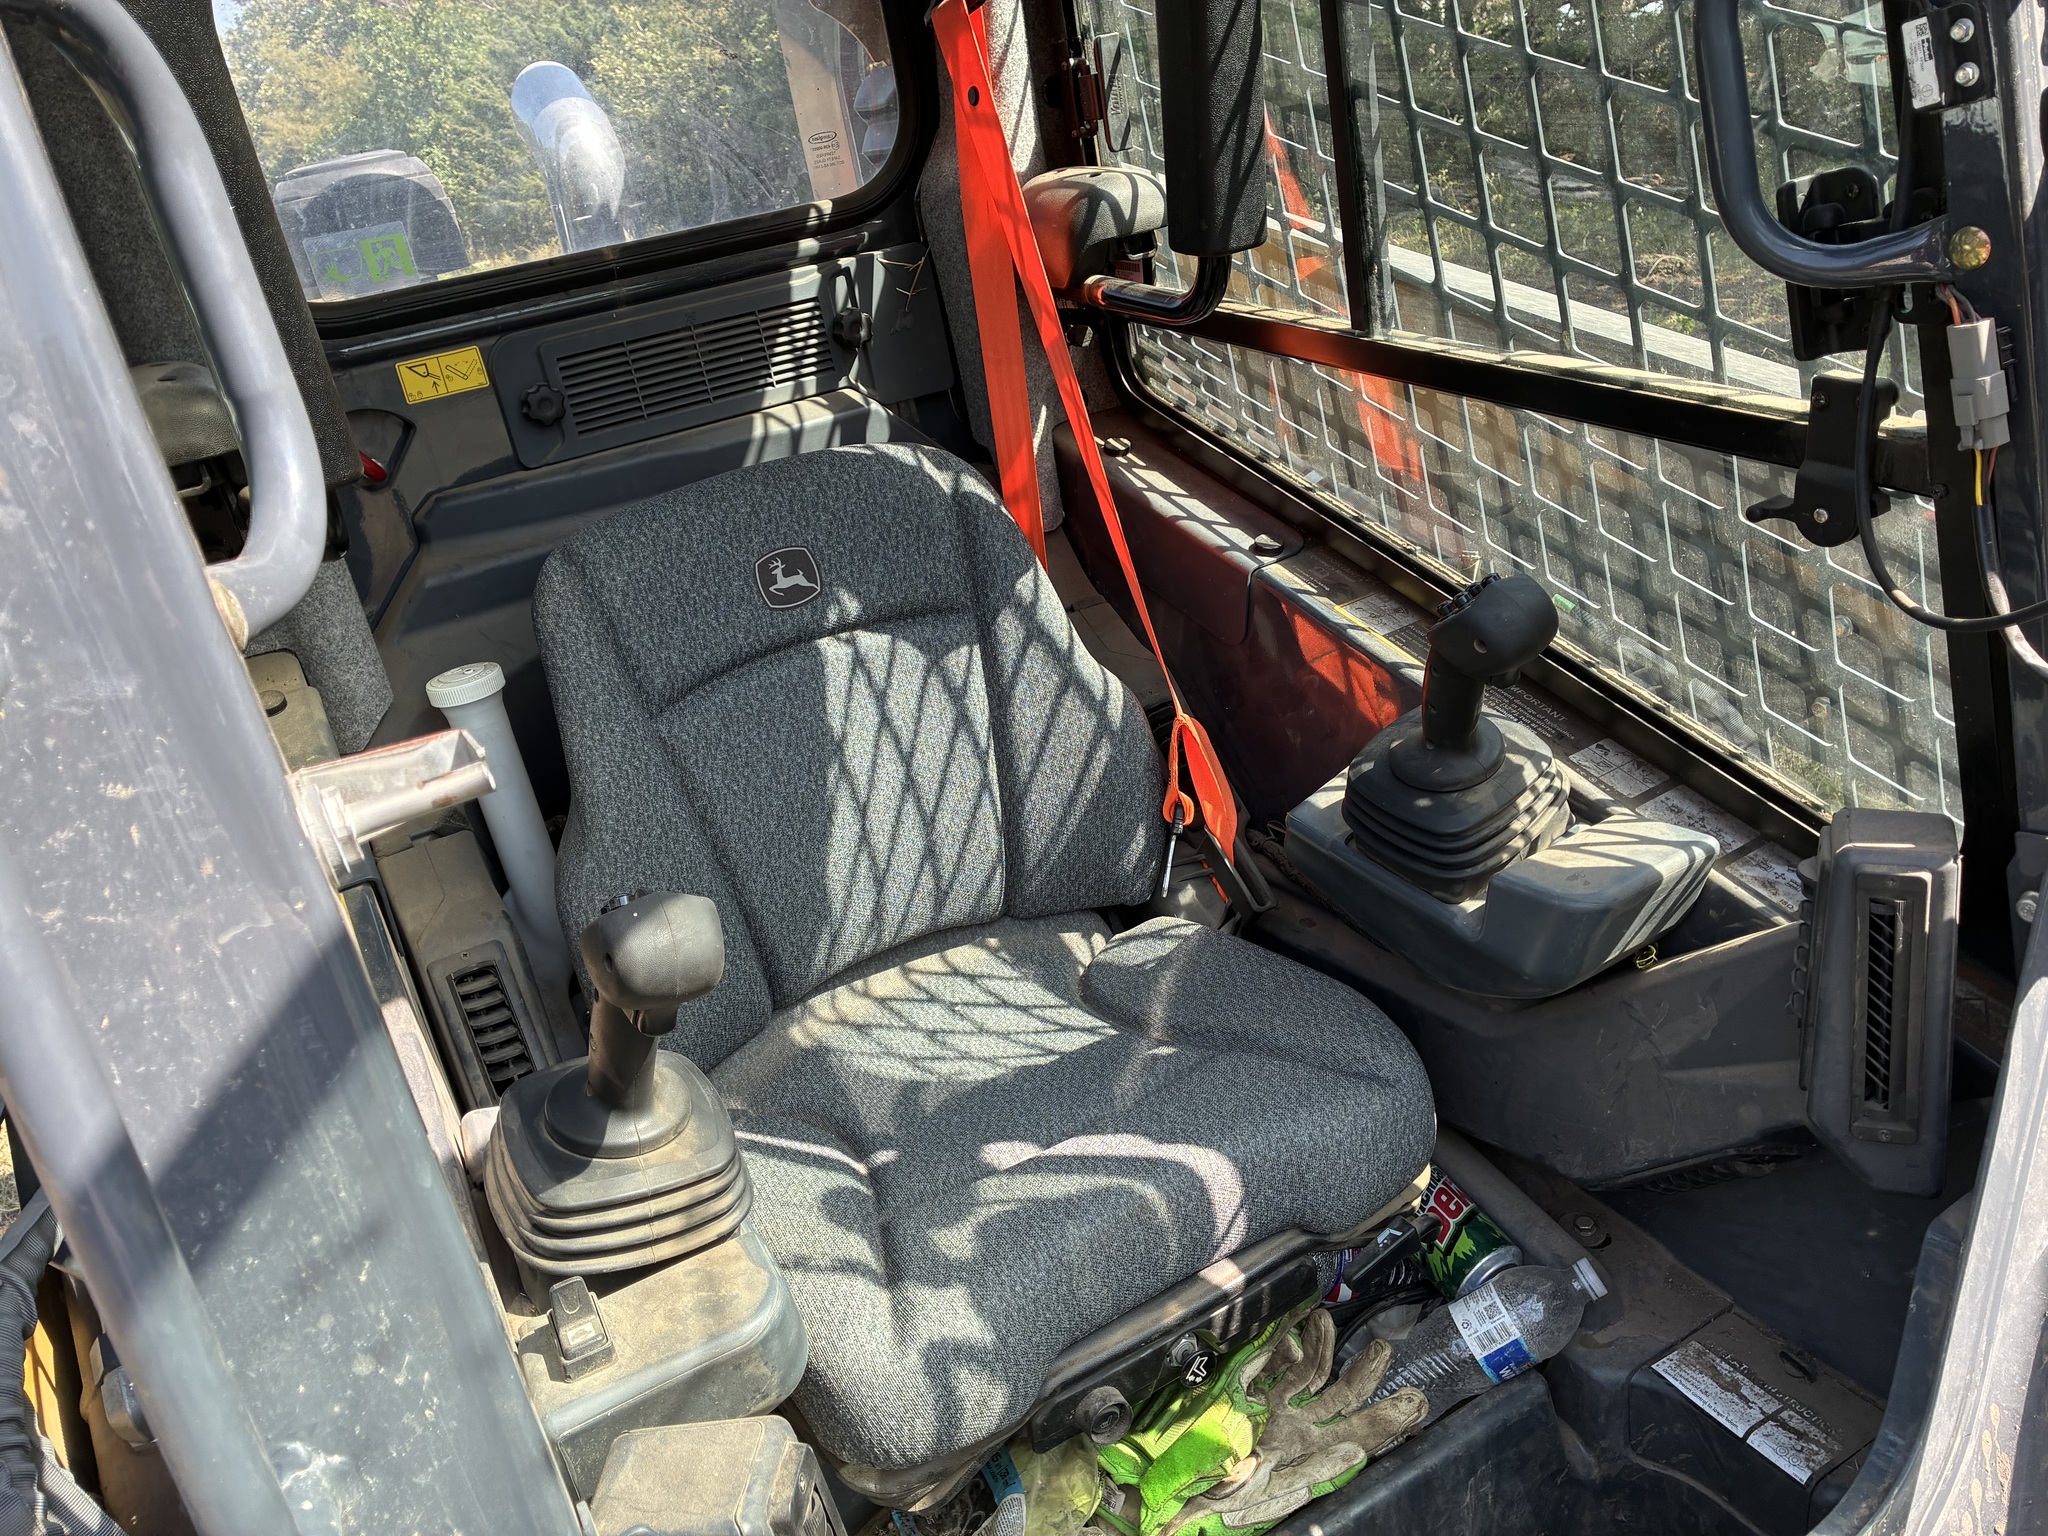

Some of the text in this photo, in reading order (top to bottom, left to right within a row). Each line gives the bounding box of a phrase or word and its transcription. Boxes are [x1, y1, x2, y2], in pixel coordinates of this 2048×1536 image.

[1508, 683, 1568, 722] MPORTANT
[1779, 898, 1794, 909] ISO
[1677, 1380, 1692, 1392] boom
[1690, 1390, 1708, 1405] control
